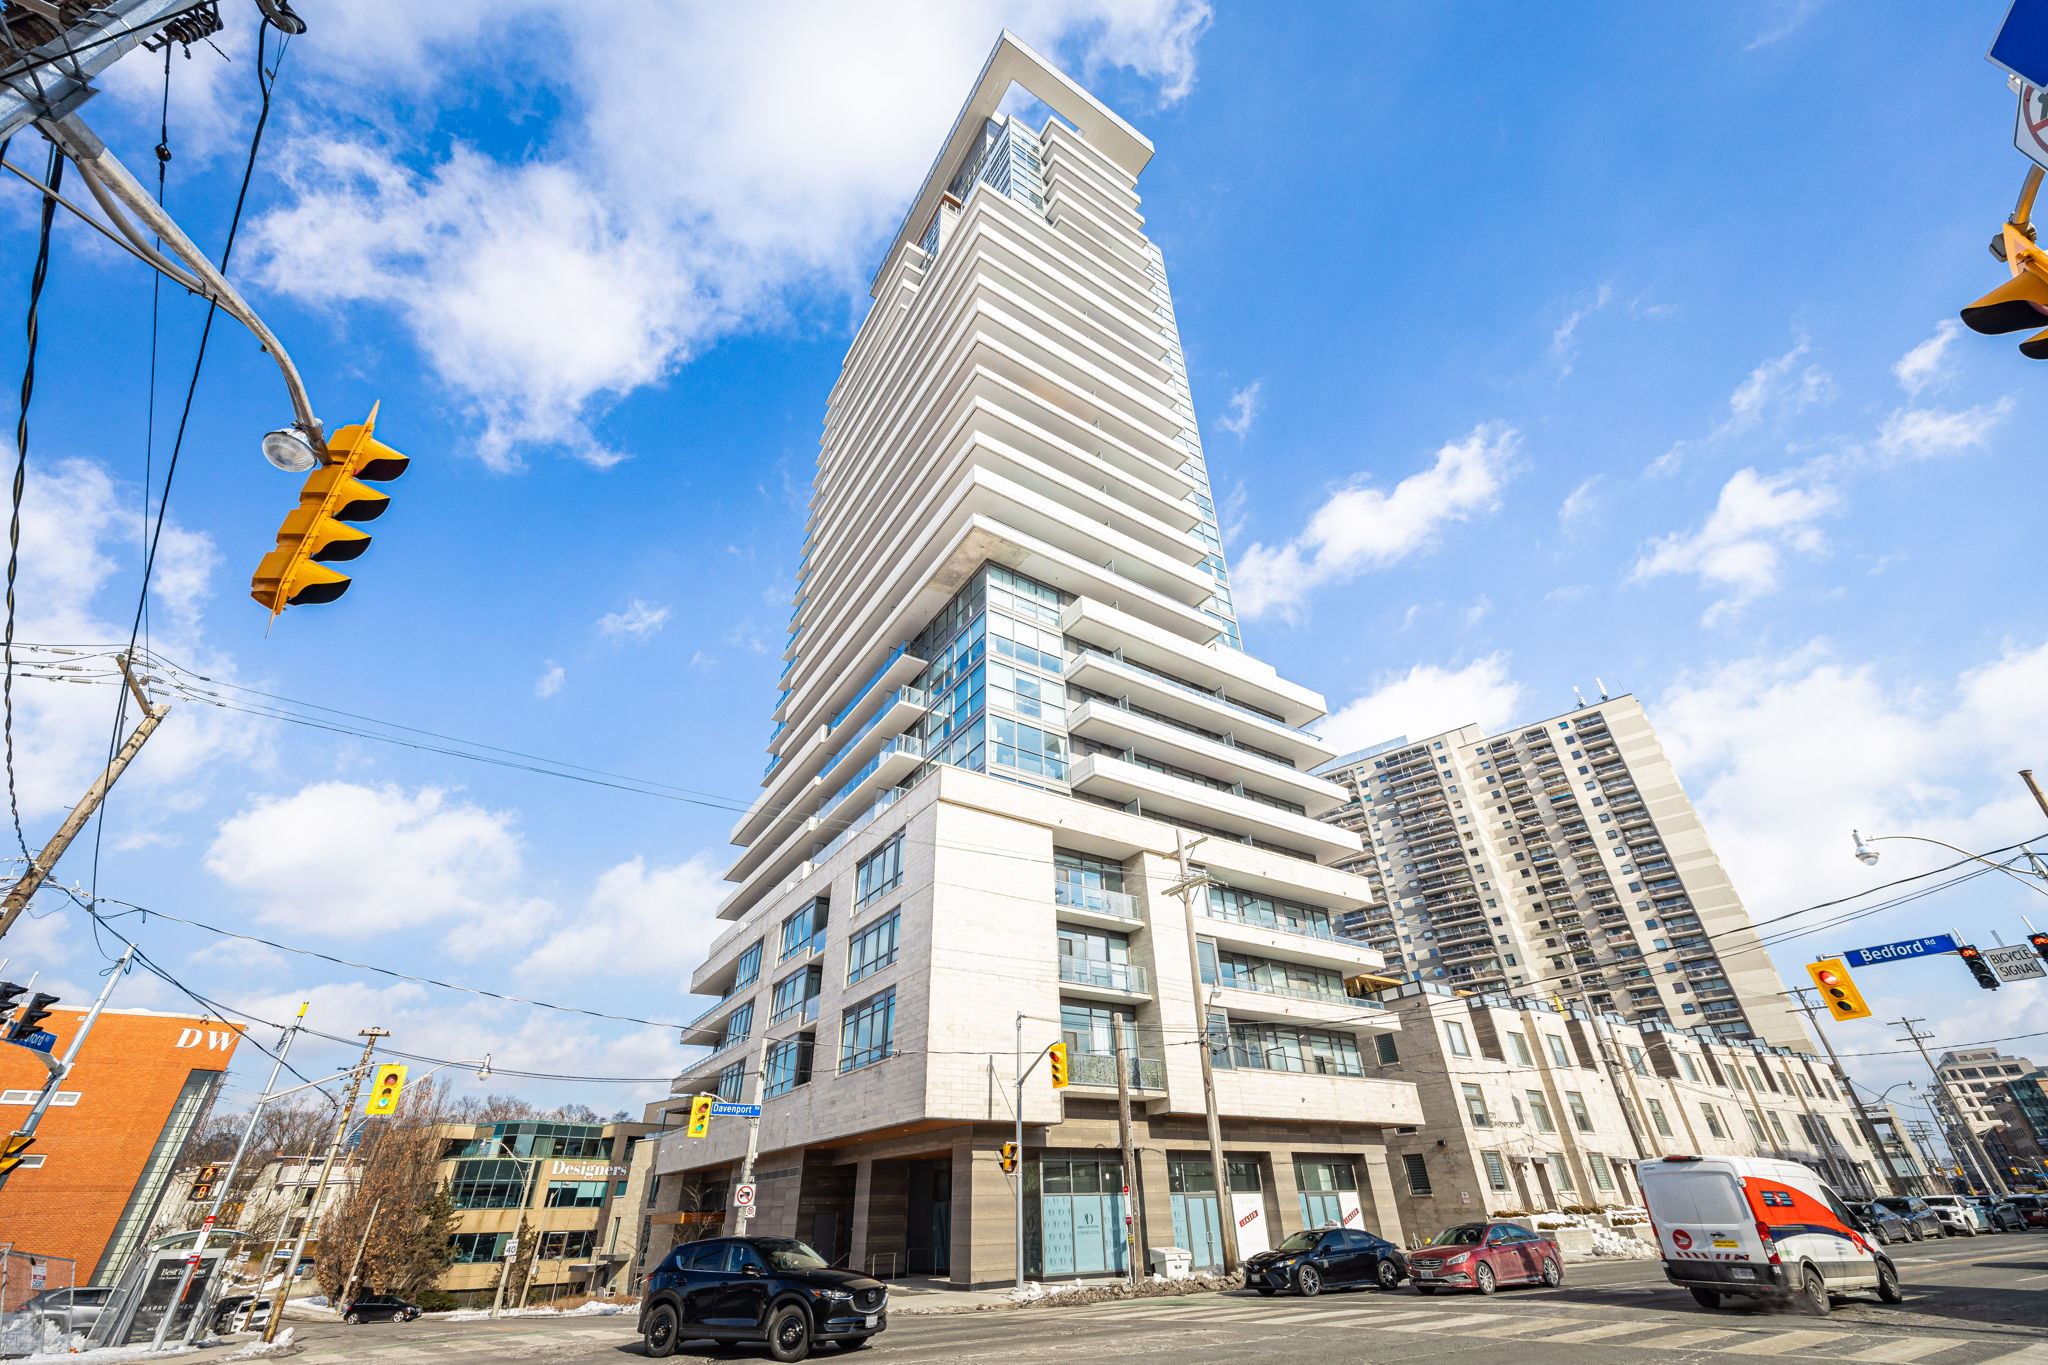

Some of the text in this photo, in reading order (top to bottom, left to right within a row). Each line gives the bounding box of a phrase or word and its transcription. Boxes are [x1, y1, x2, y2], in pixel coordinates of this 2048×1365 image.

[1860, 941, 1925, 961] Bedford
[1990, 950, 2032, 964] BICYCLE
[2000, 963, 2039, 976] SIGNAL
[713, 1104, 752, 1115] Davenport
[552, 1160, 627, 1180] Designers
[1240, 1211, 1257, 1226] LEASED
[506, 1245, 516, 1253] 40
[161, 1268, 178, 1276] Best
